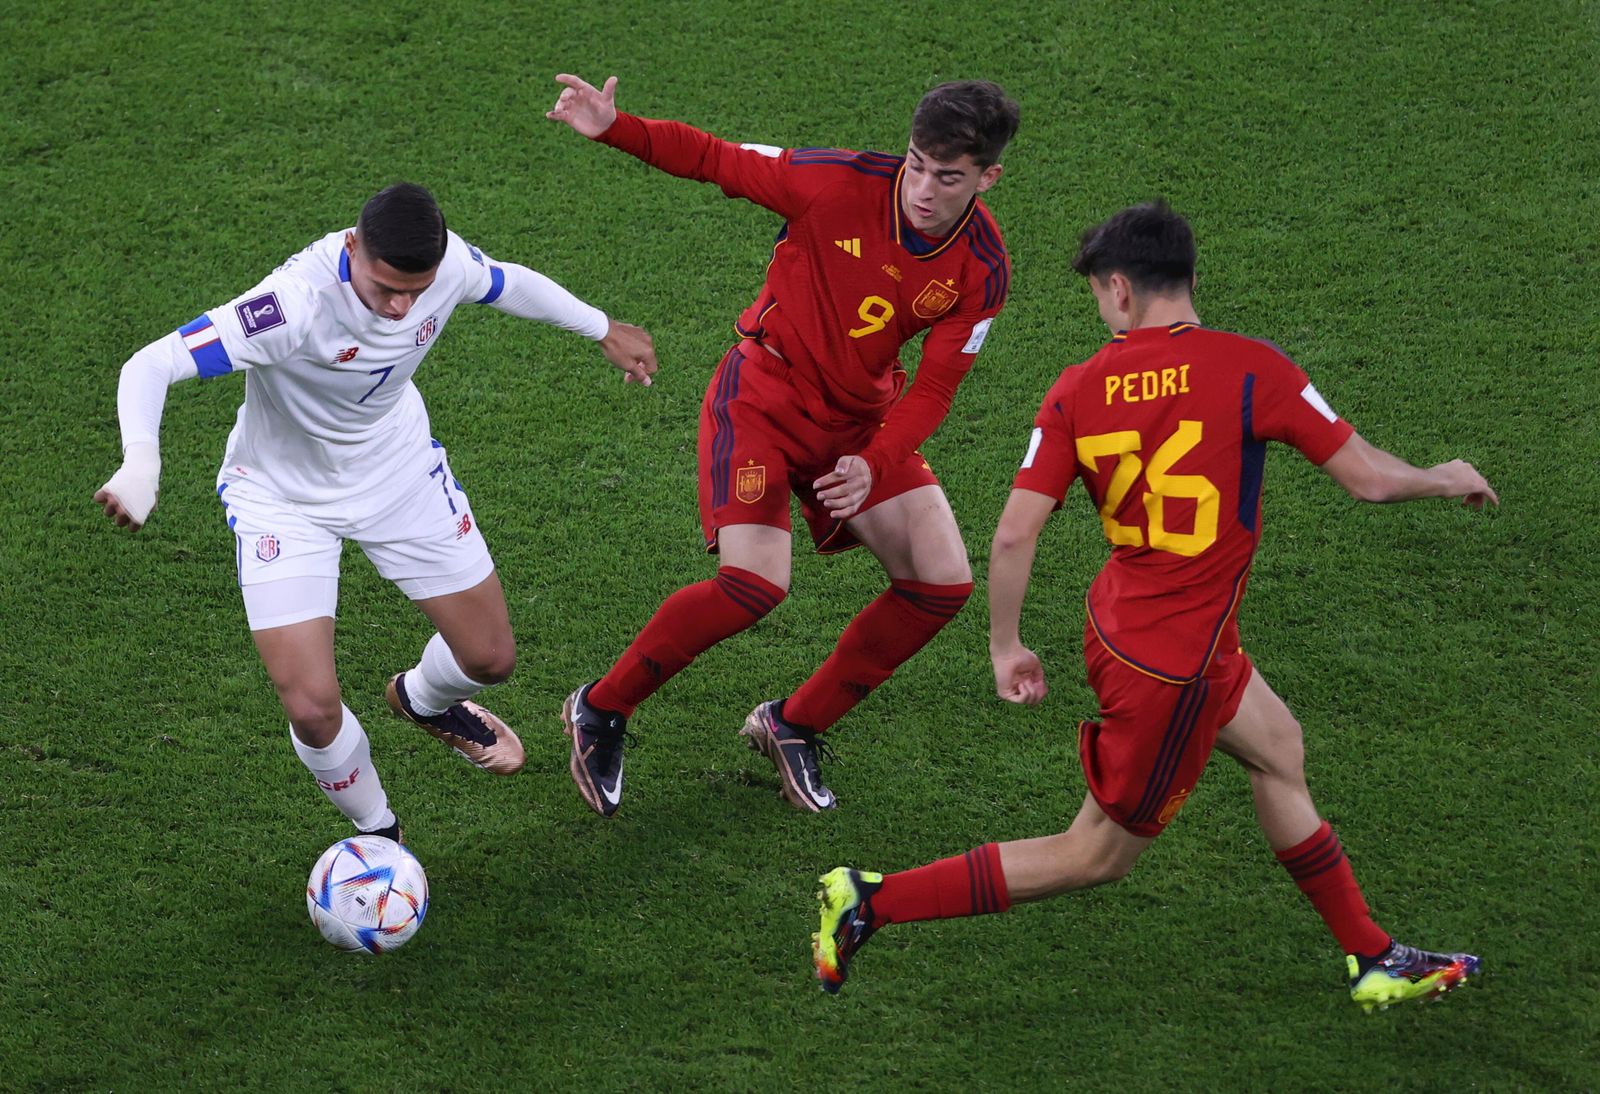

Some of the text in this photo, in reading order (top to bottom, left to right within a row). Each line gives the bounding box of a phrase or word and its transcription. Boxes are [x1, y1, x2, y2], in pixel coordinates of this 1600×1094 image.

[848, 295, 895, 338] 9
[356, 364, 396, 404] 7
[1105, 364, 1190, 405] PEDRI
[429, 461, 457, 515] 7
[1075, 420, 1220, 557] 26
